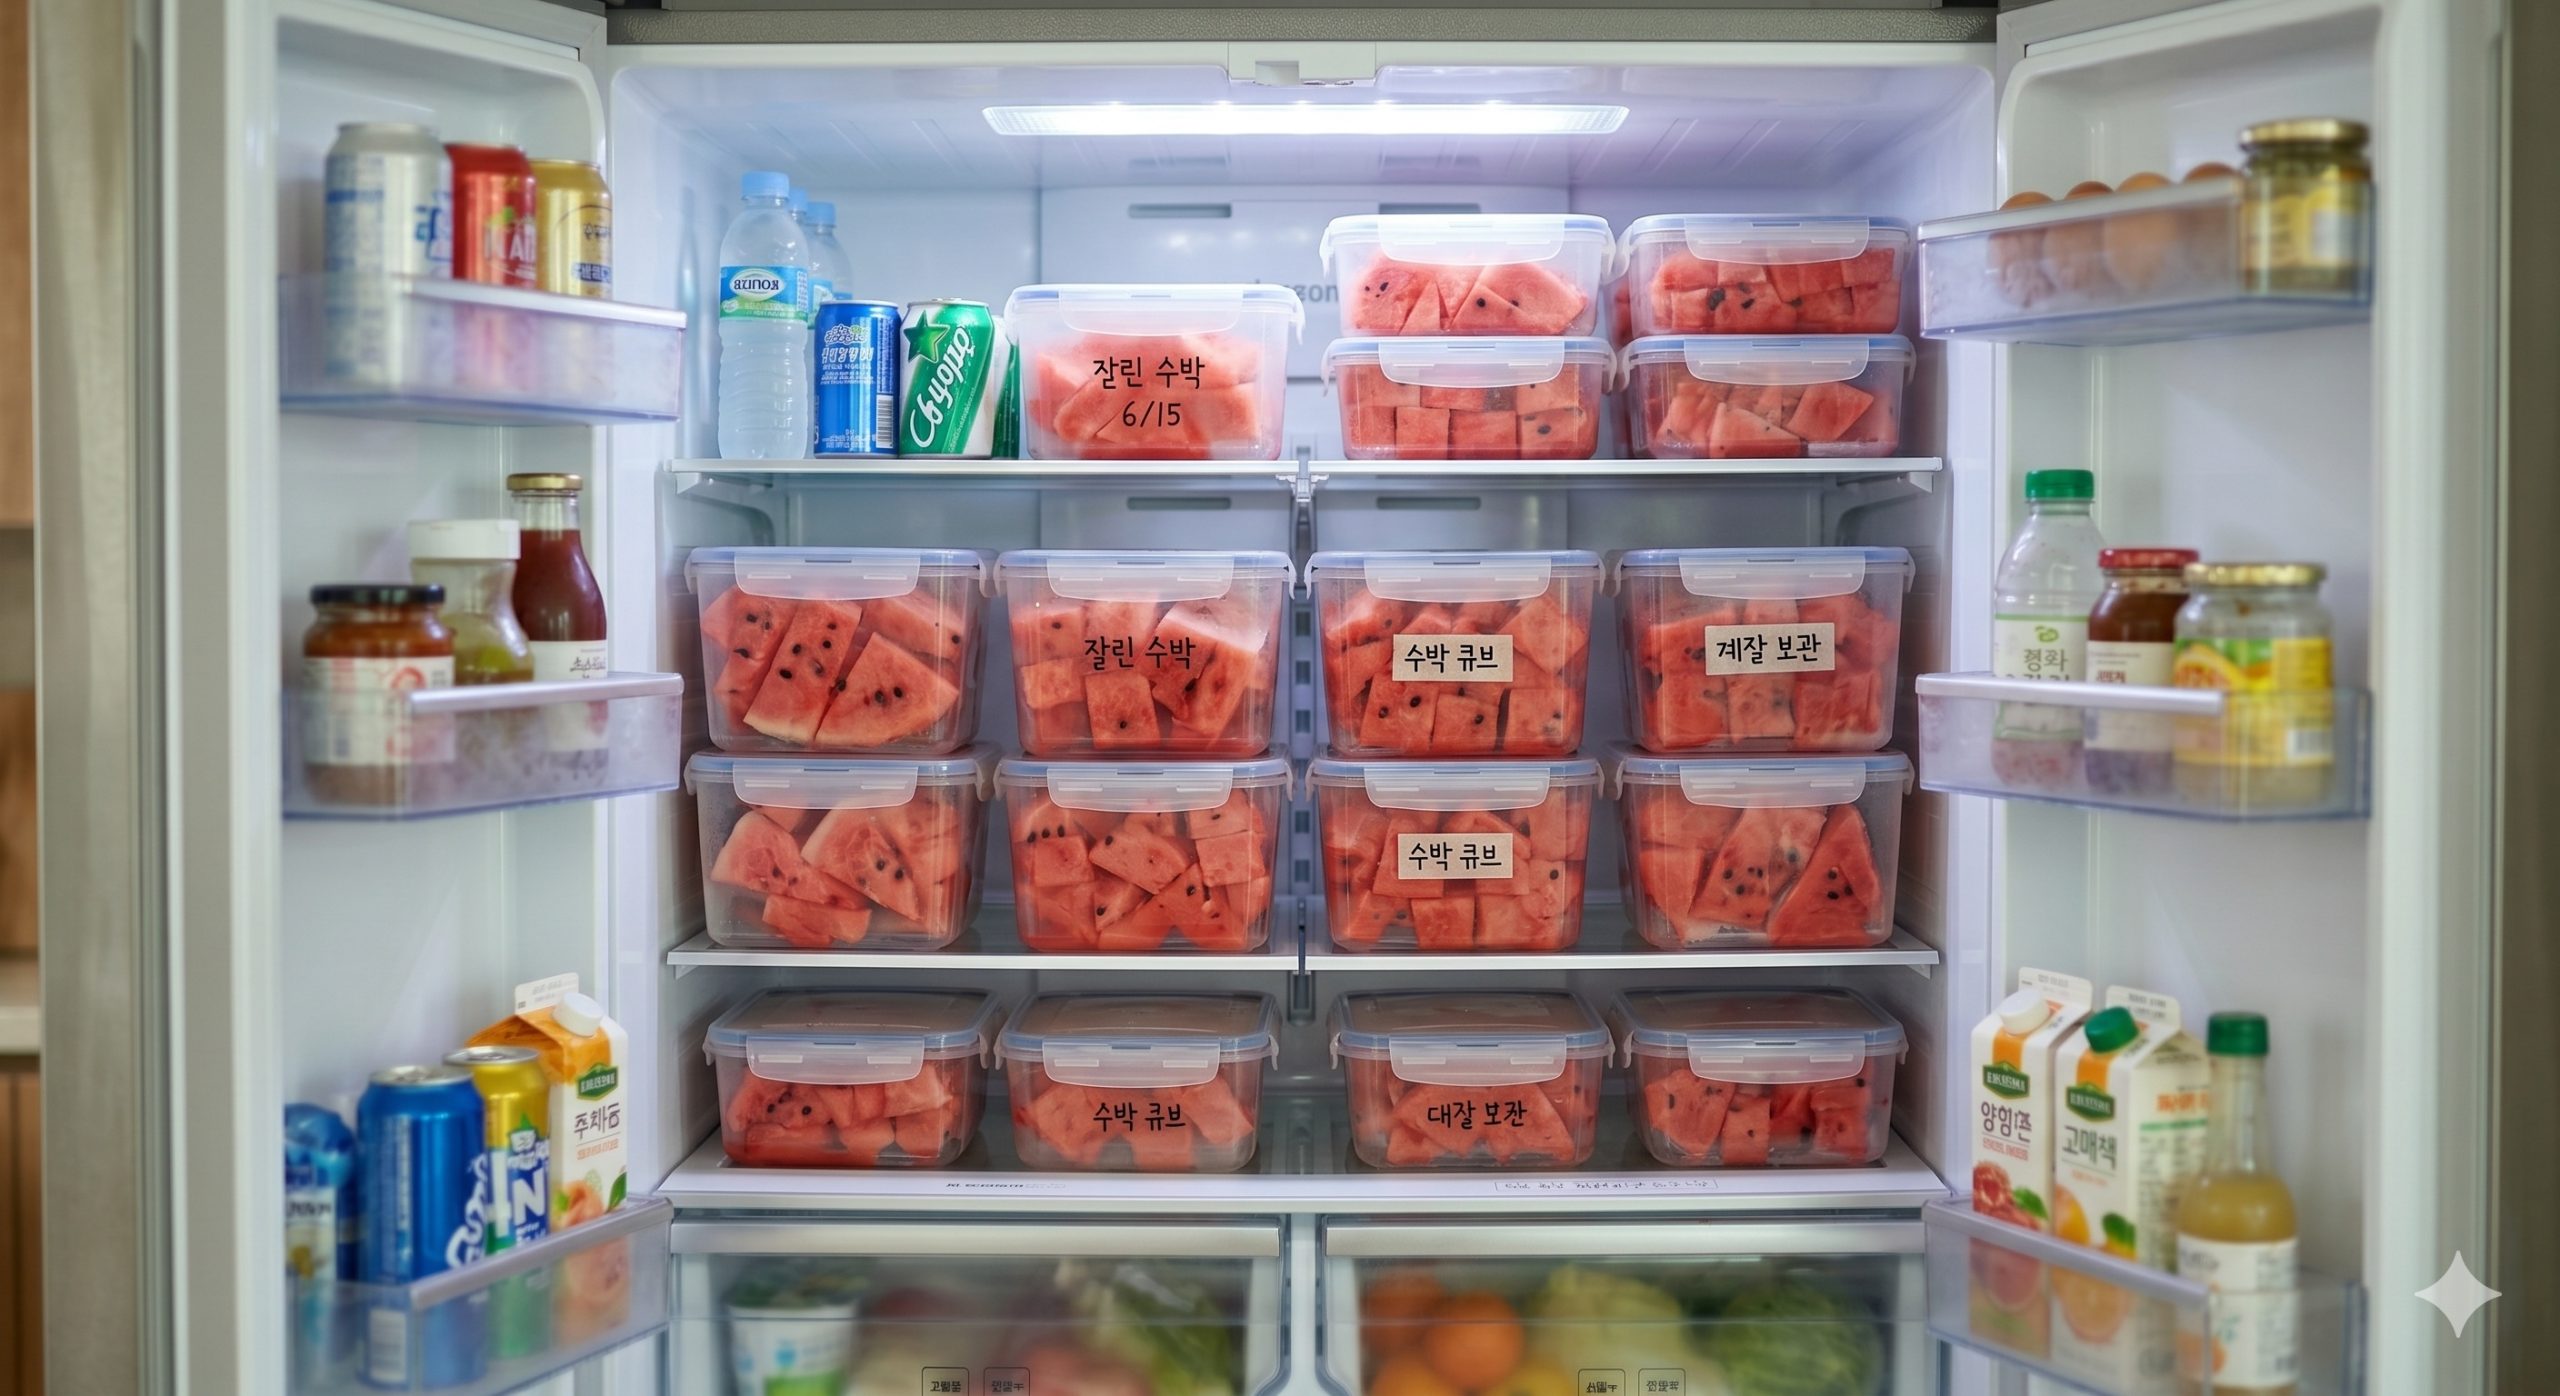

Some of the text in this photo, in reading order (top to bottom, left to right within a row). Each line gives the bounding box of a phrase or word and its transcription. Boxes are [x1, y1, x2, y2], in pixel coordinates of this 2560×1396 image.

[1093, 356, 1206, 390] 잘린 수박
[1122, 400, 1182, 428] 6/15
[1084, 635, 1197, 671] 잘린 수박
[1404, 643, 1499, 674] 수박 큐브
[1716, 632, 1822, 665] 계잘 보관
[1408, 841, 1502, 872] 수박 큐브
[1093, 1102, 1186, 1133] 수박 큐브
[1427, 1100, 1477, 1130] 대잘
